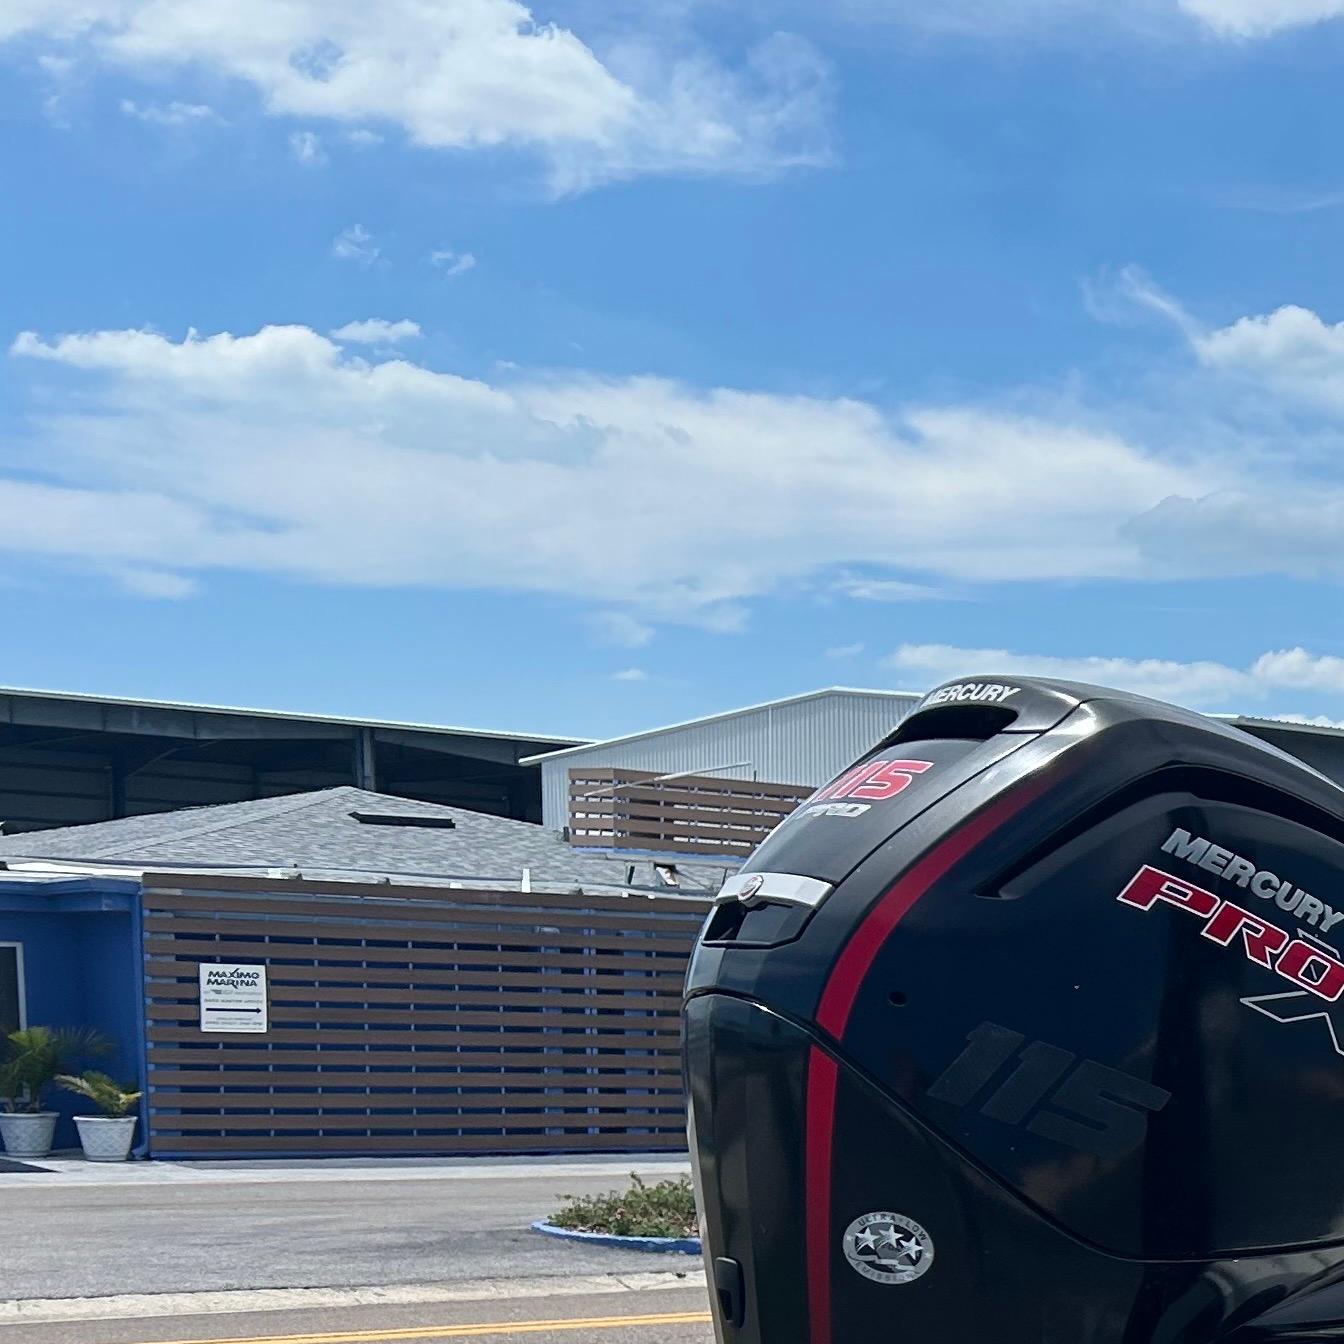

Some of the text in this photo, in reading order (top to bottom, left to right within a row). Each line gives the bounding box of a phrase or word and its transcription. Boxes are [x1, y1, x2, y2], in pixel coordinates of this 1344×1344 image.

[920, 683, 1022, 709] MERCURY
[816, 759, 935, 801] 115
[206, 979, 258, 989] MARINA
[207, 967, 260, 979] MAXIMO
[925, 1020, 1172, 1157] 115
